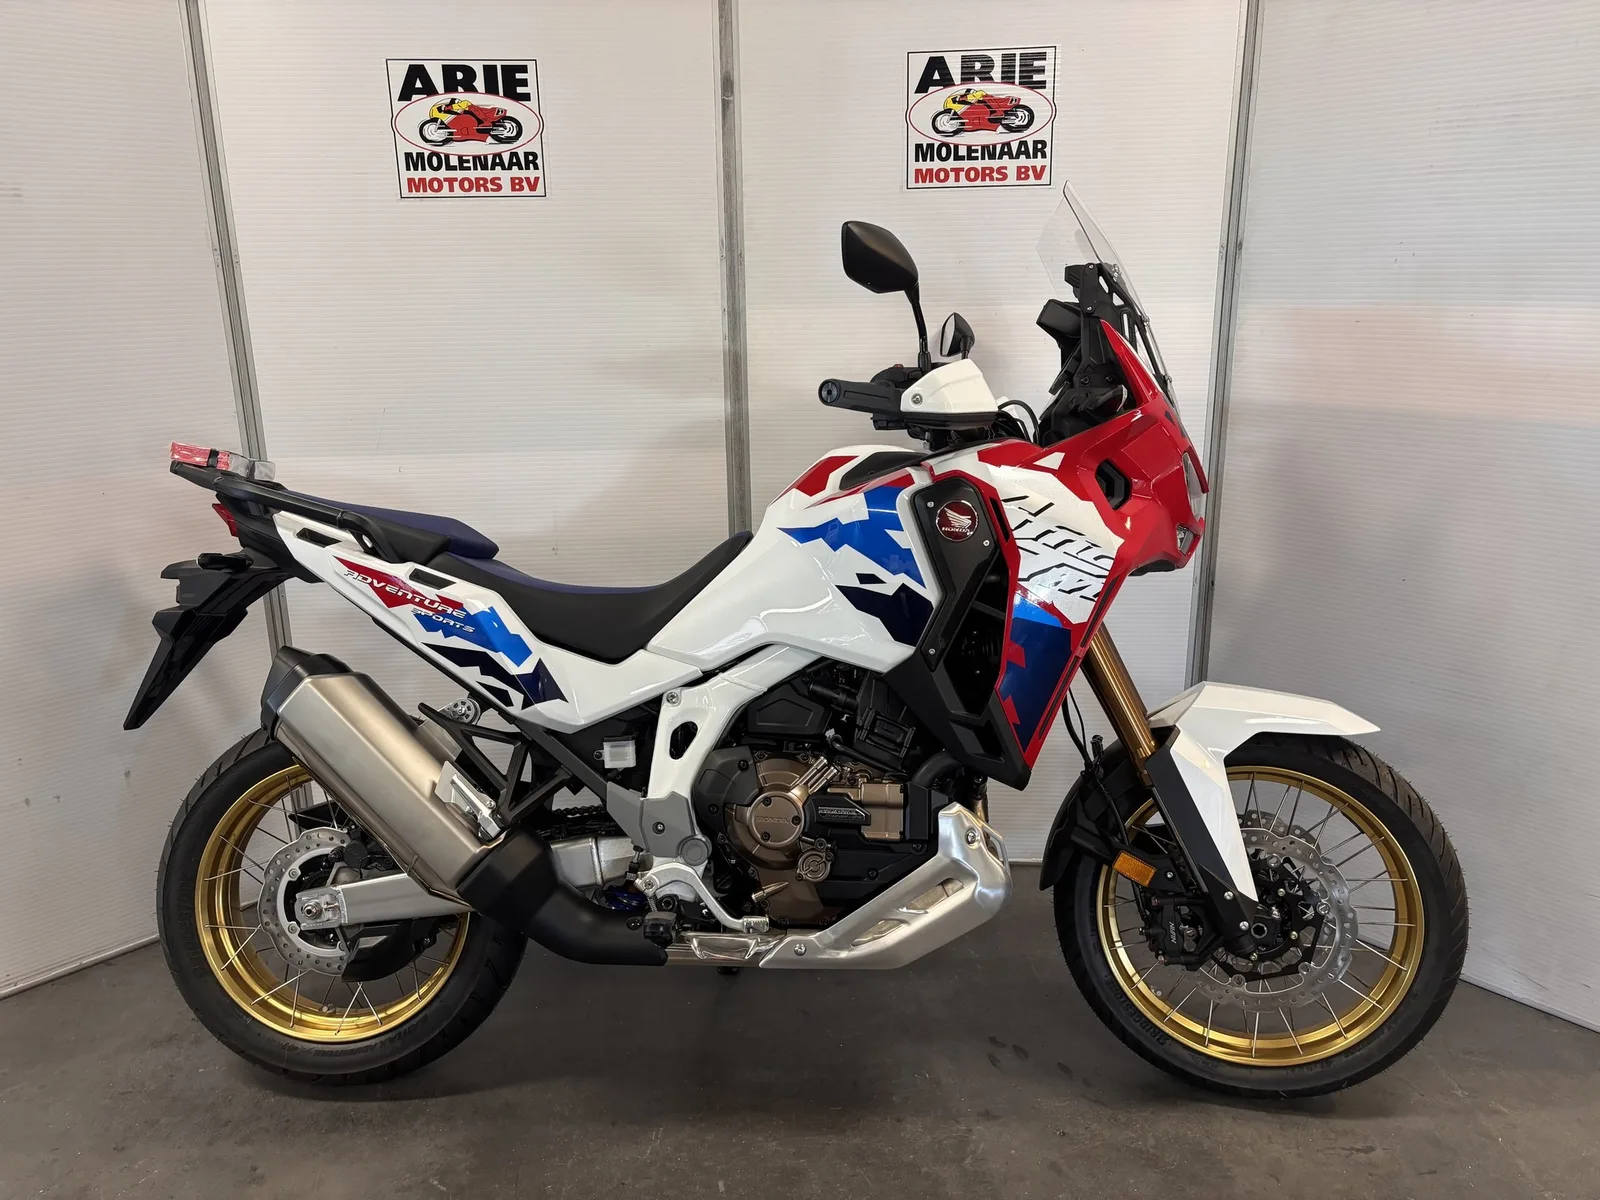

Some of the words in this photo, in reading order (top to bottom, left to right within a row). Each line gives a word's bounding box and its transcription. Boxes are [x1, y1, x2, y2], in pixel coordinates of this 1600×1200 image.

[397, 64, 531, 102] ARIE
[914, 52, 1047, 94] ARIE
[404, 151, 539, 171] MOLENAAR
[914, 139, 1047, 162] MOLENAAR
[407, 176, 503, 193] MOTORS
[510, 176, 540, 192] BV
[914, 166, 1008, 184] MOTORS
[1016, 164, 1047, 181] BV
[941, 526, 970, 534] HONDA
[344, 570, 467, 619] ADVENTURE
[411, 607, 476, 633] SPORTS
[755, 815, 789, 825] HONDA
